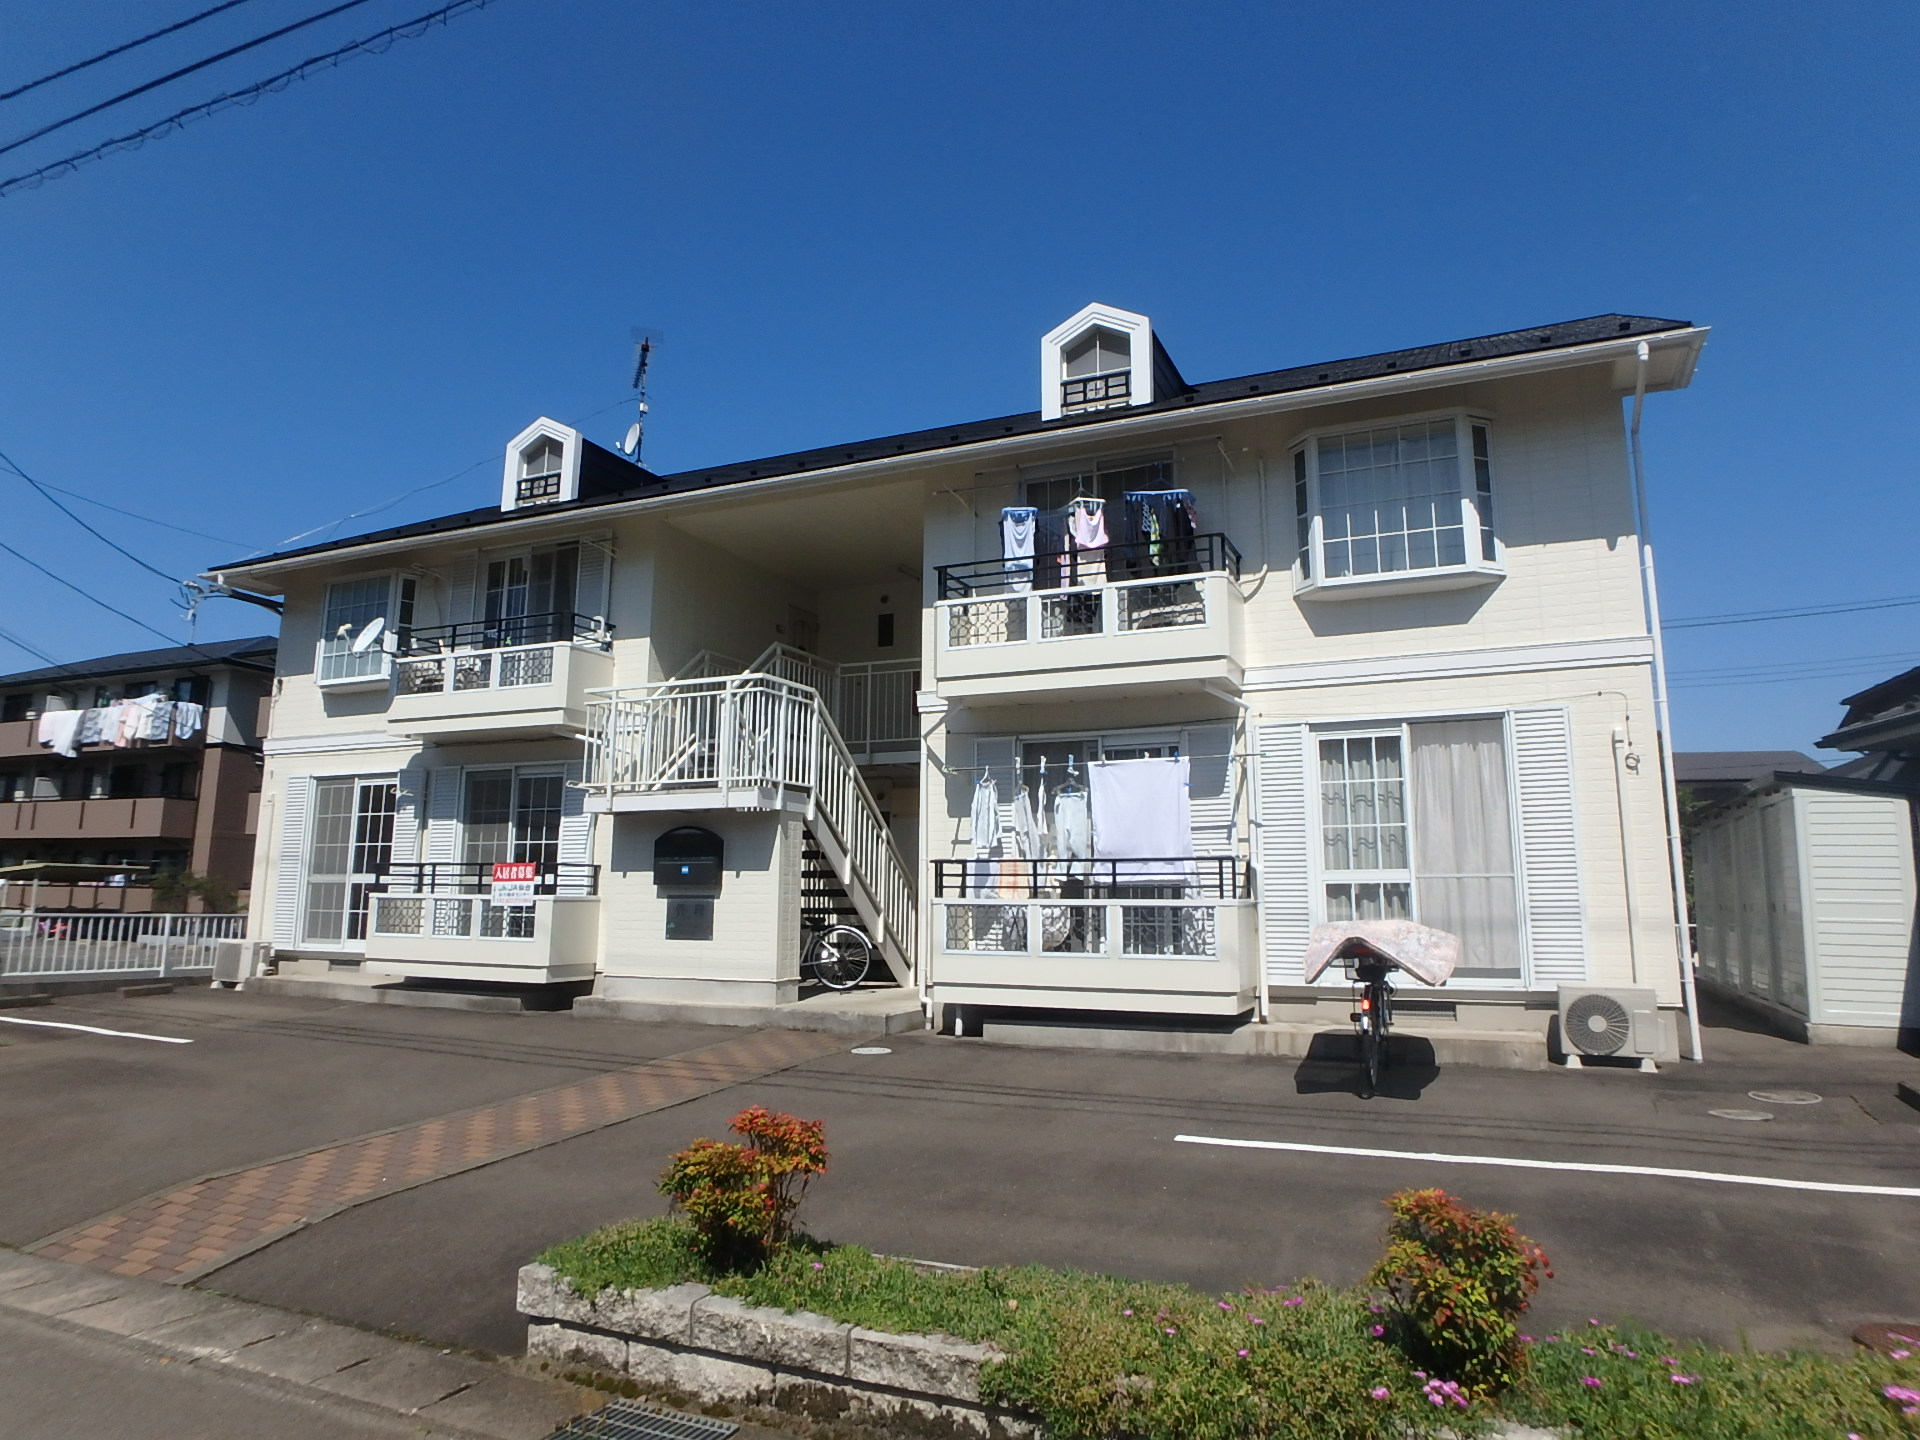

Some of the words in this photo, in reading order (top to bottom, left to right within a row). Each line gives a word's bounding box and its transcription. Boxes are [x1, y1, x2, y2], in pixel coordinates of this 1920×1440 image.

[494, 866, 533, 879] 入居者募集
